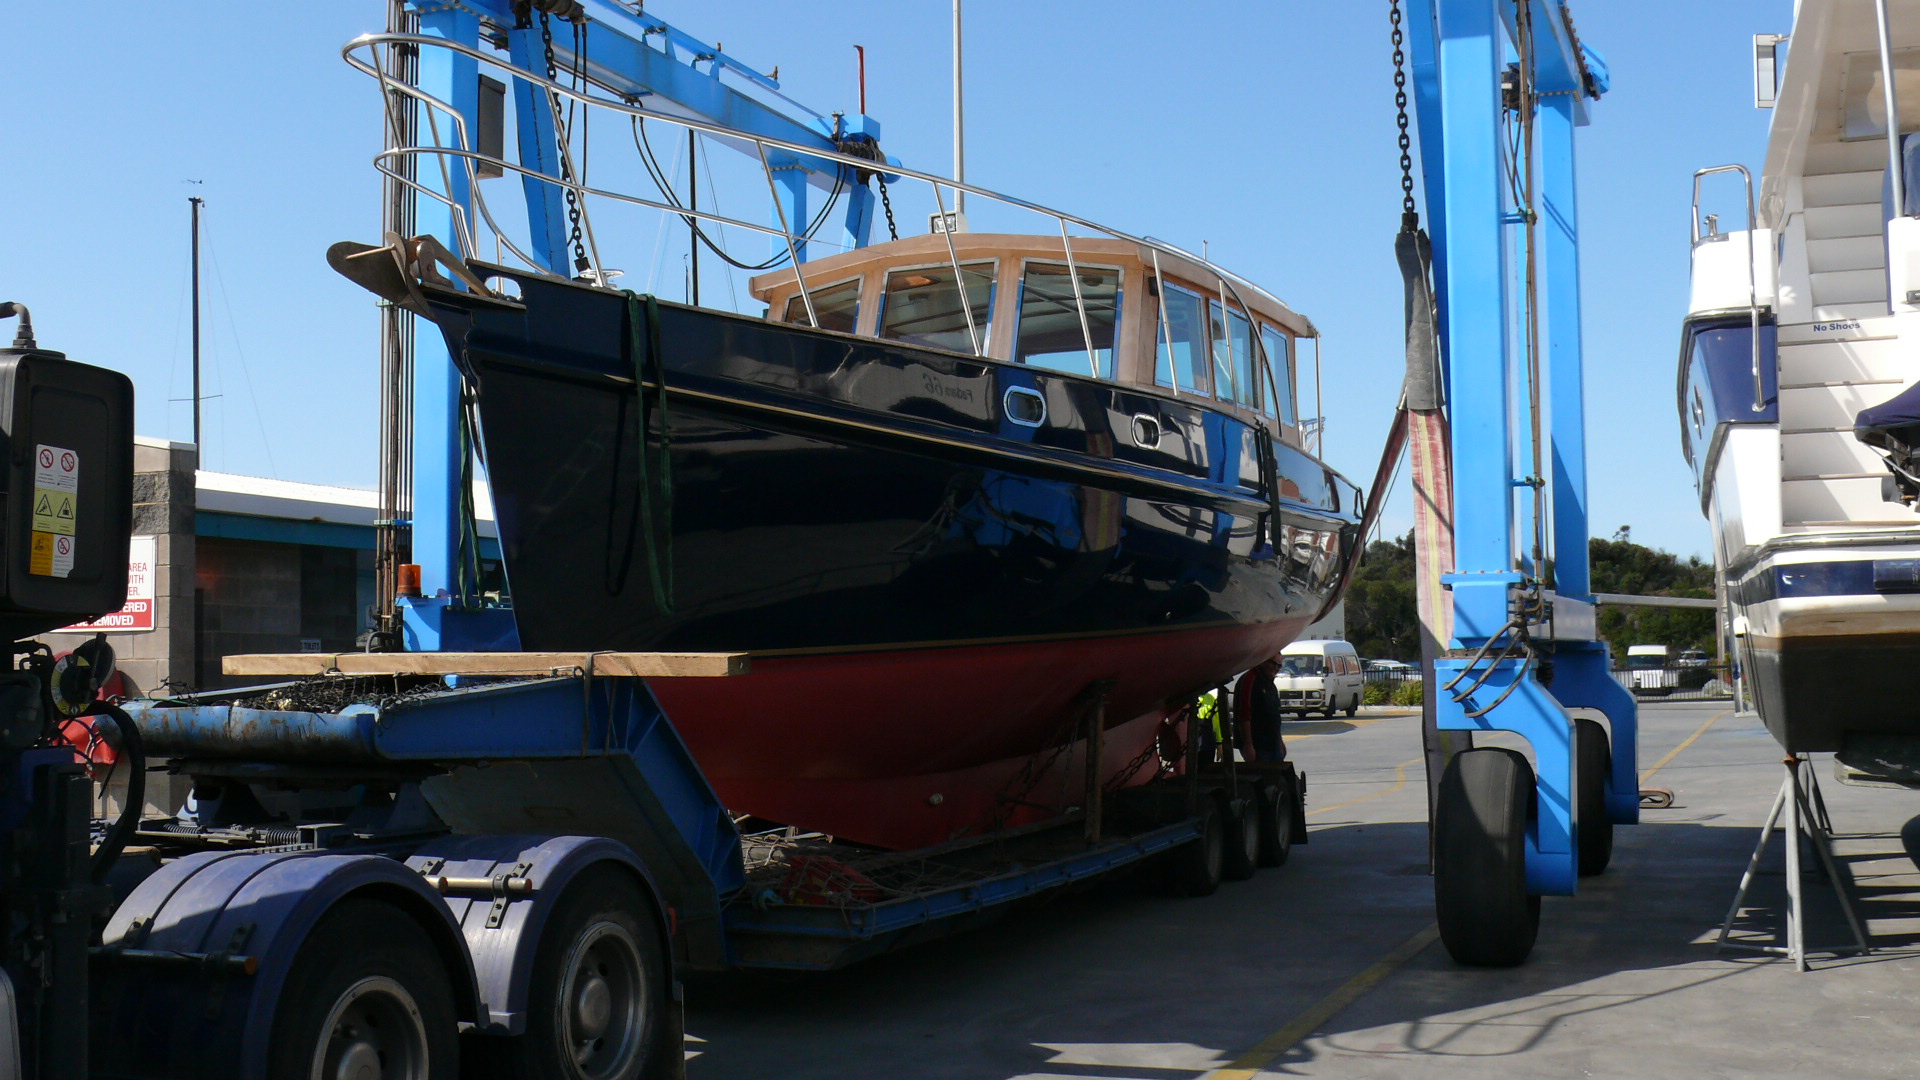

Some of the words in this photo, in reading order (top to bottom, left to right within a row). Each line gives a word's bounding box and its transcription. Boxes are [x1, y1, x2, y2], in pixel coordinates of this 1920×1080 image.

[1829, 323, 1861, 331] Shoes
[127, 586, 140, 596] ER.
[120, 601, 148, 613] ERED
